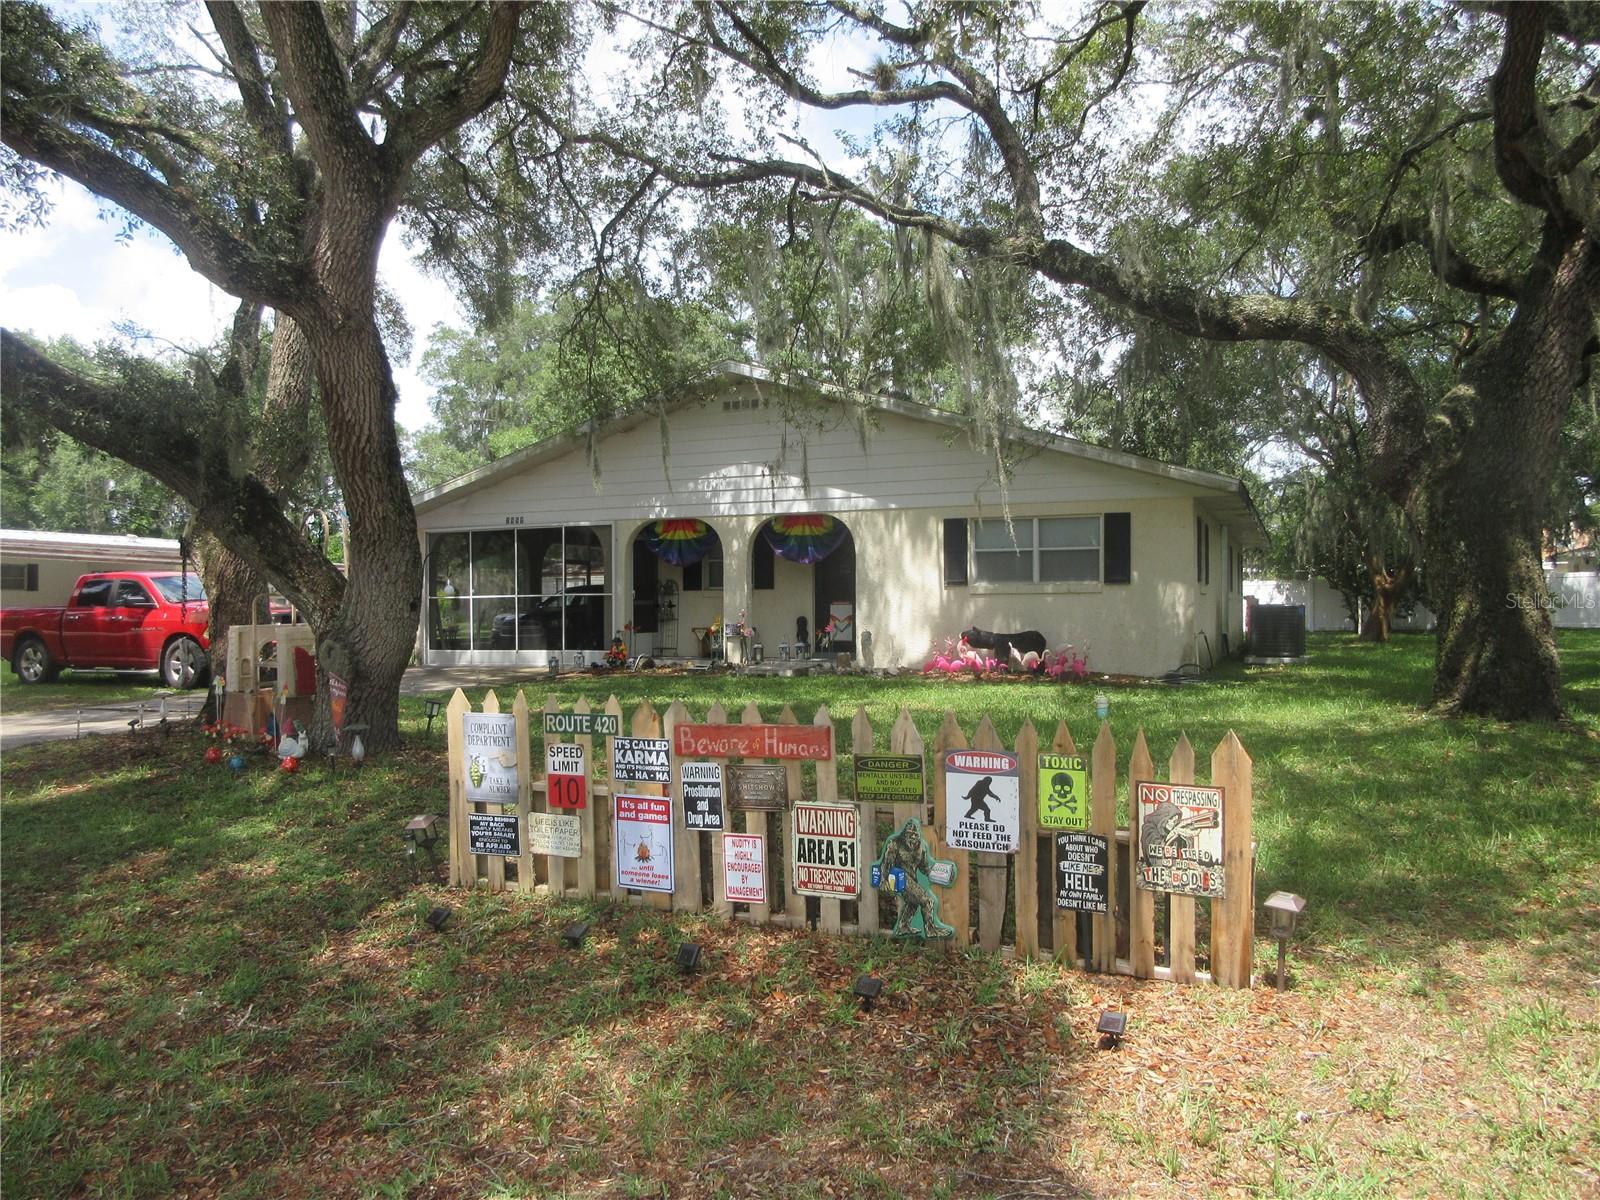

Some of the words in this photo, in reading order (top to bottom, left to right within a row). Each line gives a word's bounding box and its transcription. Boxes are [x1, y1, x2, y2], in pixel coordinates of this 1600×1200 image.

[470, 722, 507, 735] COMPLAINT
[546, 714, 591, 733] ROUTE
[594, 716, 617, 733] 420
[467, 734, 511, 748] DEPARTMENT
[614, 739, 631, 749] IT'S
[632, 740, 669, 751] CALLED
[679, 726, 750, 755] Beware
[752, 737, 761, 751] of
[764, 727, 829, 757] Humans
[549, 746, 583, 759] SPEED
[615, 749, 669, 766] KARMA
[552, 760, 580, 773] LIMIT
[867, 760, 909, 769] DANGER
[954, 754, 1010, 770] WARNING
[1043, 755, 1082, 770] TOXIC
[615, 769, 629, 779] HA
[635, 770, 648, 780] HA
[656, 771, 670, 781] HA
[682, 765, 720, 779] WARNING
[488, 777, 503, 786] TAKE
[738, 783, 775, 791] SHITSHOW
[488, 785, 511, 794] NUMBER
[553, 778, 580, 805] 10
[683, 784, 721, 798] Prostitution
[882, 786, 917, 794] MEDICATED
[1142, 787, 1169, 802] NO
[1172, 789, 1218, 807] TRESPASSING
[621, 800, 635, 809] It's
[637, 801, 648, 810] all
[650, 802, 665, 811] fun
[696, 799, 709, 811] and
[619, 810, 636, 819] and
[637, 812, 668, 821] games
[687, 811, 703, 828] Drug
[704, 813, 720, 826] Area
[1043, 815, 1064, 825] STAY
[1065, 816, 1083, 826] OUT
[797, 808, 854, 836] WARNING
[959, 821, 990, 832] PLEASE
[992, 824, 1005, 832] DO
[952, 829, 970, 839] NOT
[972, 831, 992, 841] FEED
[995, 833, 1012, 842] THE
[485, 842, 512, 850] AFRAID
[731, 839, 751, 848] NUDITY
[751, 839, 757, 849] IS
[955, 839, 1010, 851] SASQUATCH
[1057, 835, 1069, 845] YOU
[1070, 834, 1087, 843] THINK
[1091, 837, 1107, 850] CARE
[797, 837, 835, 866] AREA
[838, 840, 855, 868] 51
[1065, 843, 1083, 852] ABOUT
[1084, 845, 1099, 854] WHO
[734, 851, 753, 861] HIGHLY
[1067, 851, 1095, 863] DOESN'T
[639, 864, 655, 872] until
[727, 862, 761, 874] ENCOURAGED
[1062, 861, 1080, 871] LIKE
[621, 869, 650, 878] someone
[651, 871, 669, 880] loses
[741, 874, 748, 884] BY
[798, 867, 809, 882] NO
[809, 868, 855, 887] TRESPASSING
[1143, 866, 1166, 884] THE
[1171, 870, 1218, 891] BODIES
[727, 886, 763, 897] MANAGEMENT
[807, 883, 823, 891] BEYOND
[1059, 889, 1068, 897] MY
[1068, 890, 1082, 899] OWN
[1083, 891, 1104, 902] FAMILY
[1057, 897, 1082, 909] DOESN'T
[1082, 900, 1096, 910] LIKE
[1096, 902, 1107, 912] ME
